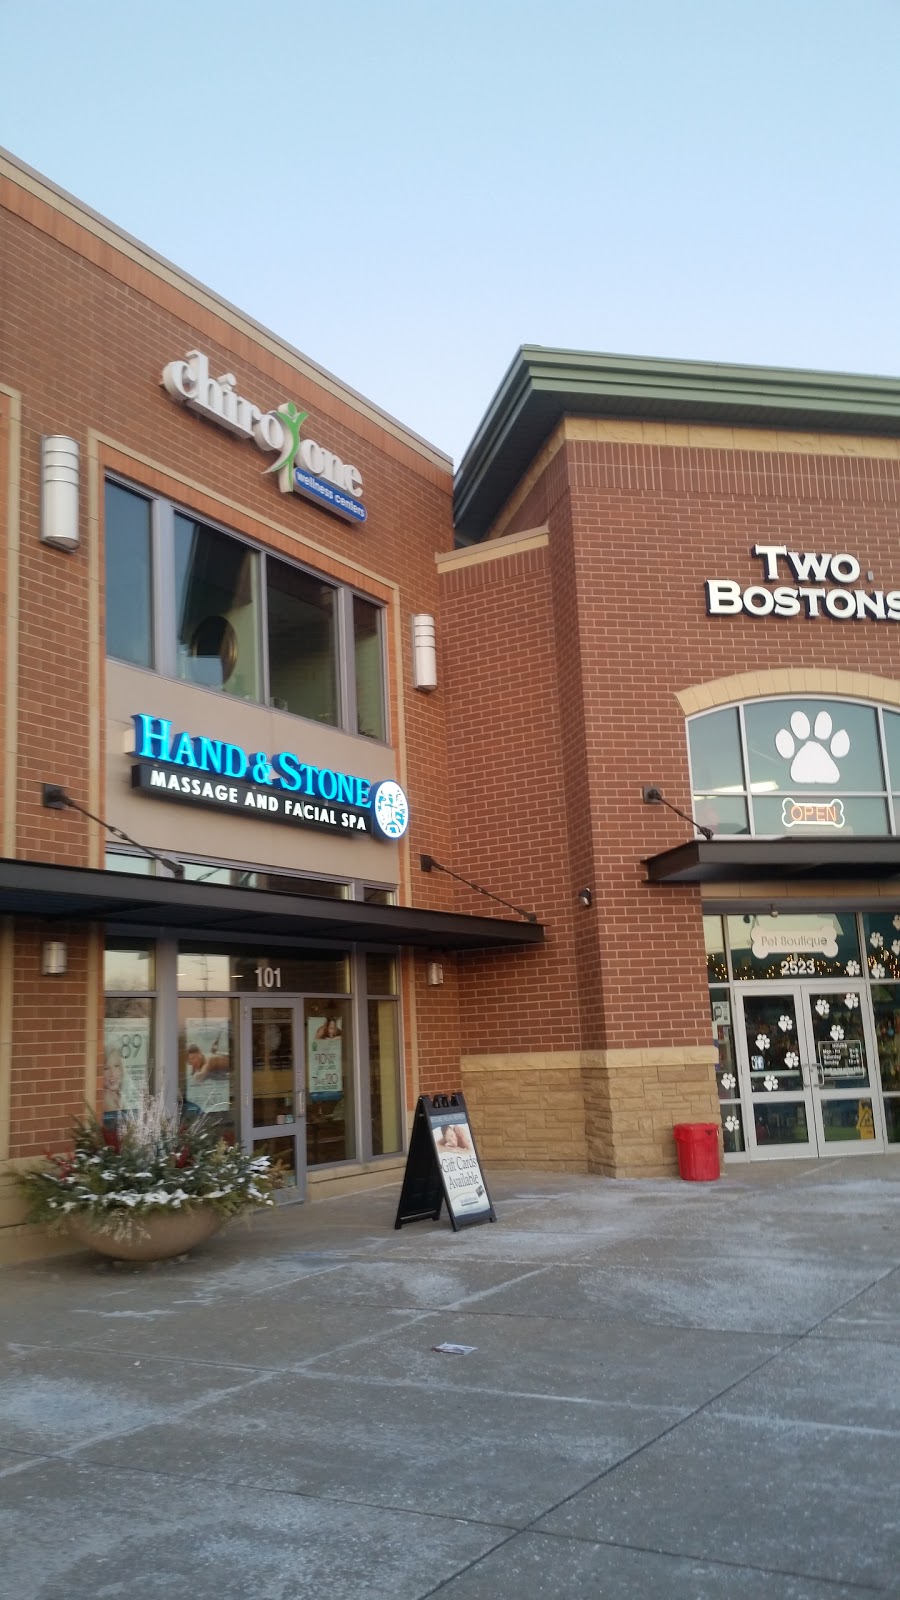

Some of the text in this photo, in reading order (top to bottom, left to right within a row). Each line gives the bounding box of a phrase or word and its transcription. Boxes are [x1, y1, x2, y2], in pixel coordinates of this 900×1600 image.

[296, 471, 365, 518] wellness centers
[752, 544, 861, 583] TWO
[272, 752, 372, 809] STONE
[150, 770, 367, 831] MASSAGE AND FACIAL SPA
[790, 805, 837, 822] OPEN
[761, 936, 828, 948] Pet Boutique
[254, 967, 282, 988] 101
[780, 960, 816, 975] 2523
[441, 1155, 477, 1173] Gift Cards
[449, 1171, 480, 1190] Available
